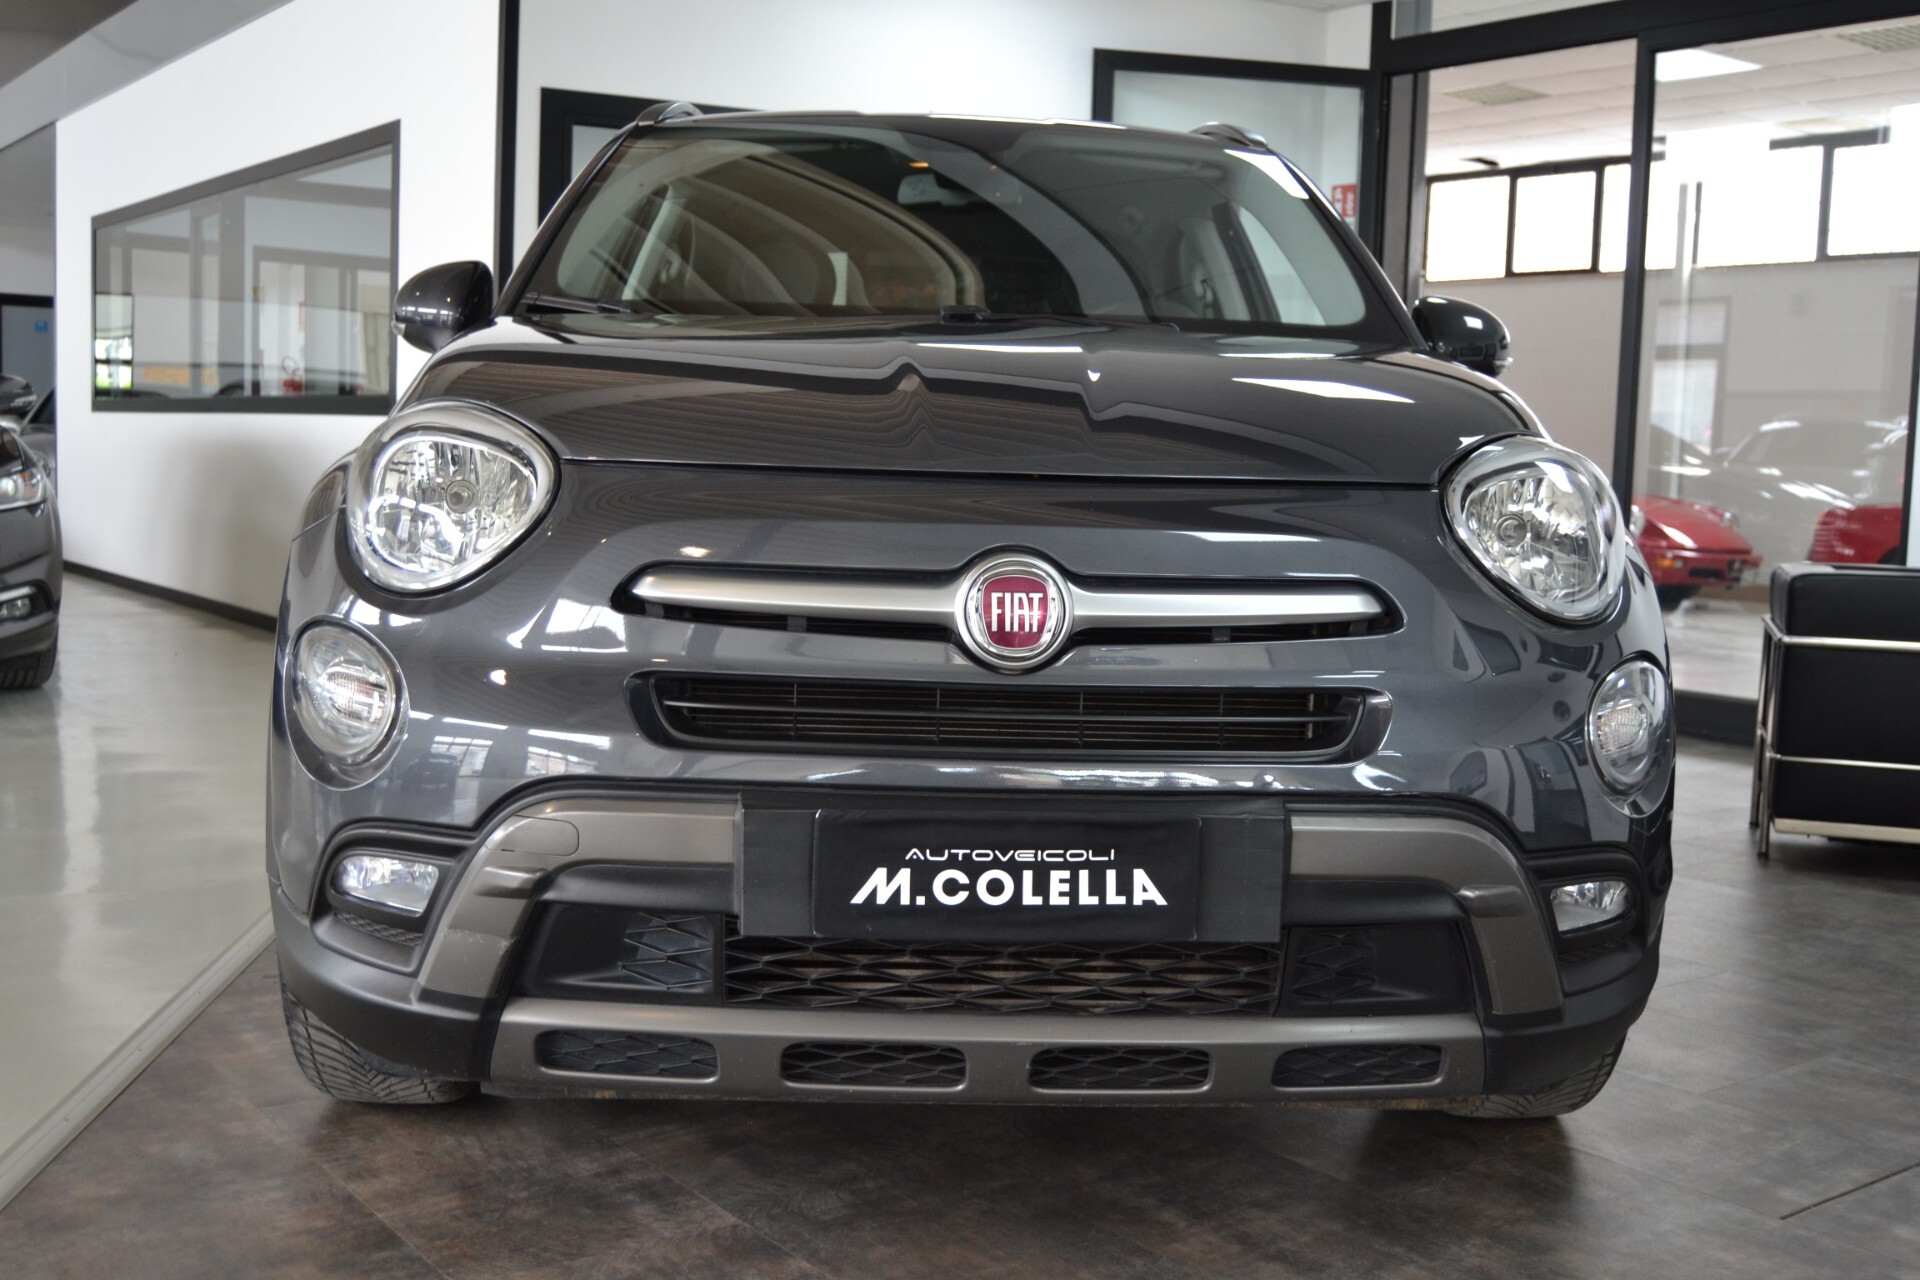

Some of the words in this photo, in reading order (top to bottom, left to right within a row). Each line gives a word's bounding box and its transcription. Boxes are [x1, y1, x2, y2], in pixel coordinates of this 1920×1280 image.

[991, 592, 1043, 632] FIAT
[905, 848, 1115, 861] AUTOVEICOLI
[850, 867, 1168, 905] M.COLELLA
